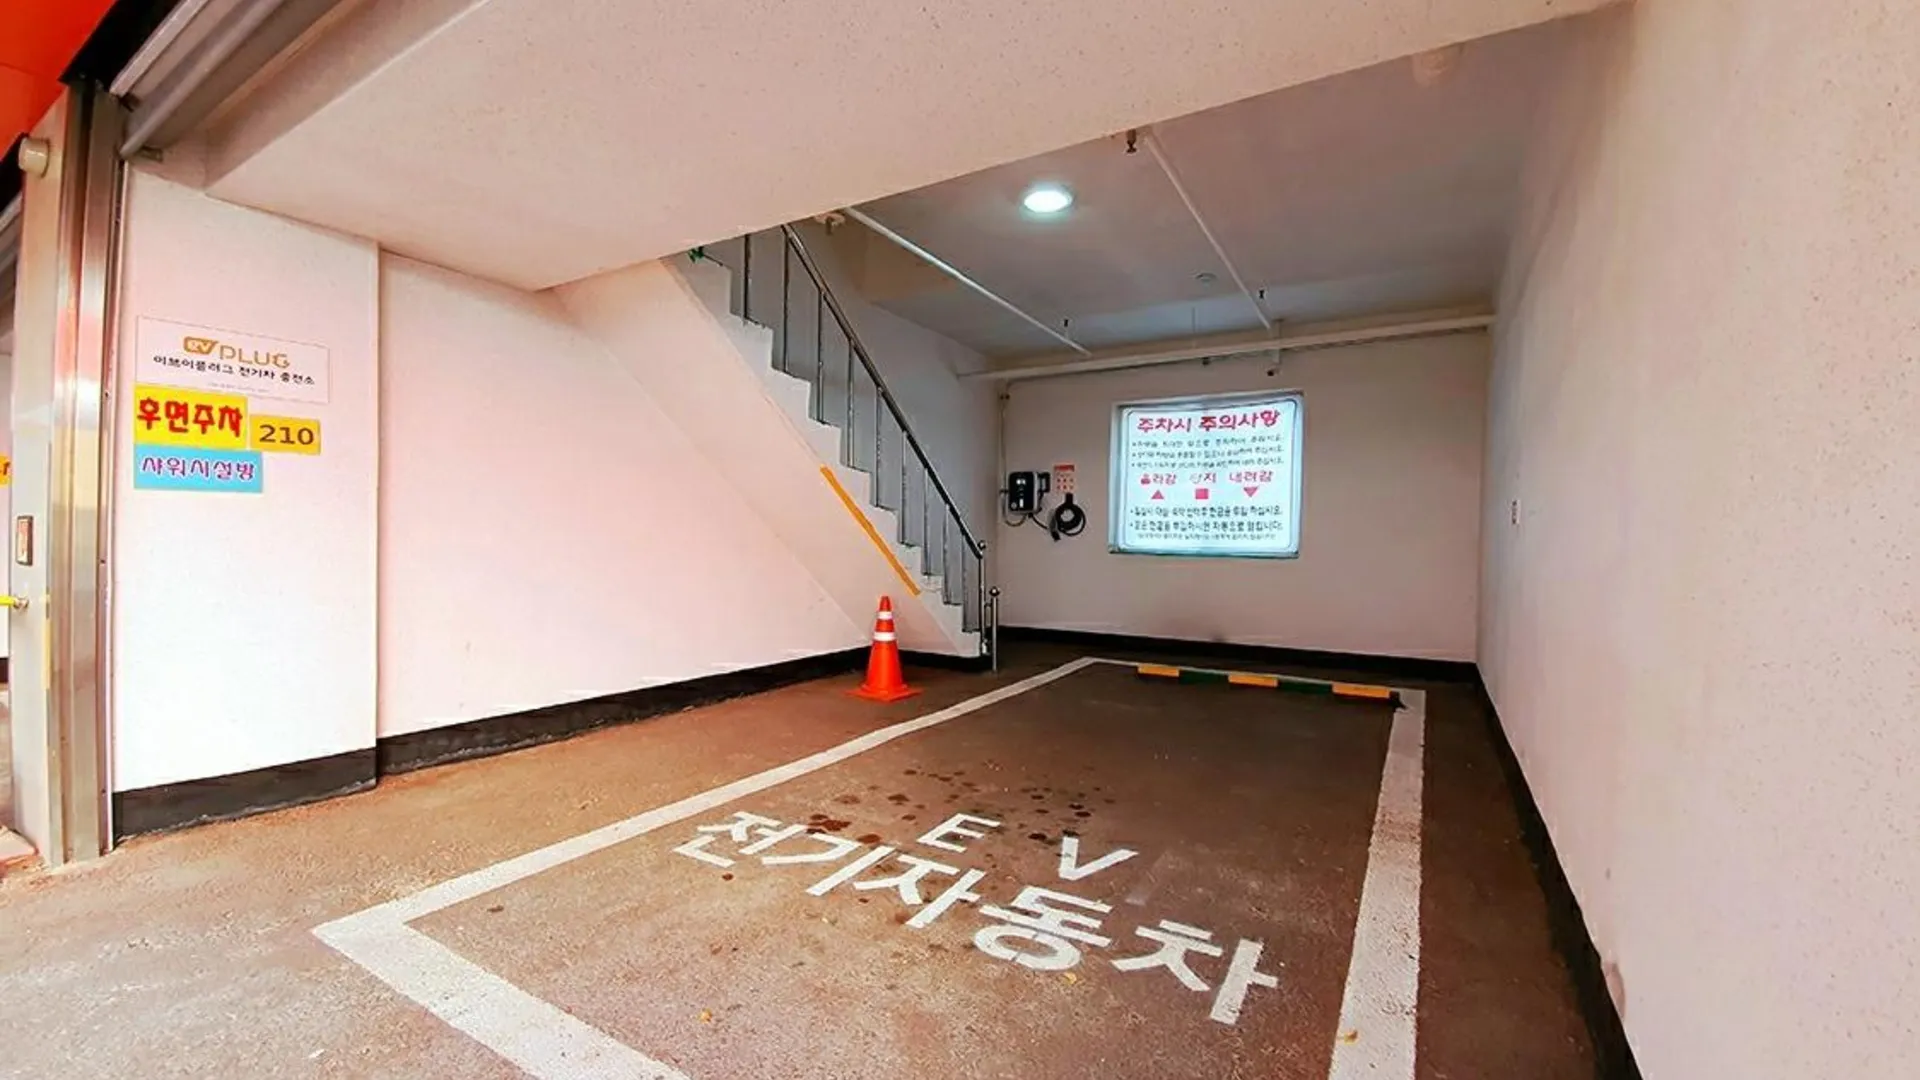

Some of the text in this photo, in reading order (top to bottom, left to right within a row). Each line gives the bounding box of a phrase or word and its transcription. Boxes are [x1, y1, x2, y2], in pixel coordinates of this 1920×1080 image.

[137, 397, 243, 438] 후면주차
[1138, 410, 1281, 433] 주차시 주의사항
[259, 424, 315, 446] 210
[673, 811, 1279, 1025] 전기자동차
